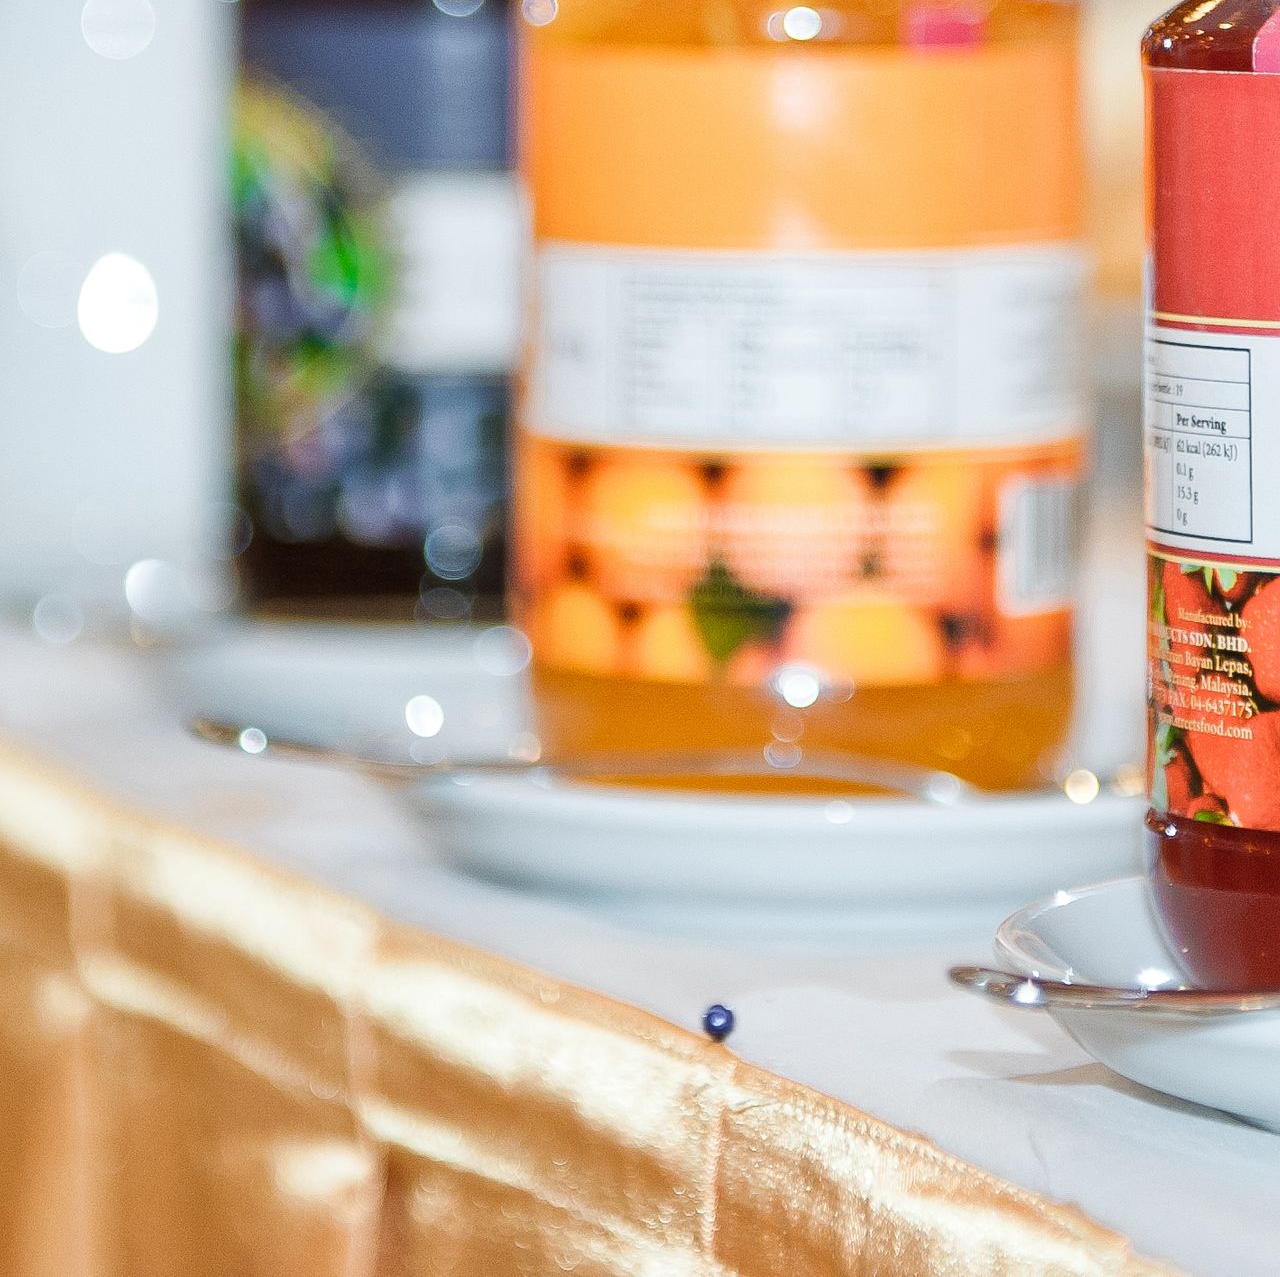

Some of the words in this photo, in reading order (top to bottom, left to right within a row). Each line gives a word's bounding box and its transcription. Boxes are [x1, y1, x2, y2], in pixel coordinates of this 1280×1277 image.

[1176, 413, 1189, 426] Per
[1191, 415, 1227, 435] Serving
[1176, 440, 1185, 453] 62
[1186, 441, 1201, 456] kcal
[1202, 442, 1222, 459] (262
[1223, 444, 1238, 462] kJ)
[1176, 462, 1187, 476] 0.1
[1188, 468, 1194, 482] g
[1177, 485, 1192, 500] 15.3
[1193, 490, 1199, 505] g
[1176, 509, 1182, 521] 0
[1182, 512, 1188, 526] g
[1178, 608, 1233, 627] Manufactured
[1235, 613, 1253, 632] by:
[1189, 633, 1216, 648] SDN.
[1217, 633, 1252, 653] BHD.
[1185, 651, 1213, 672] Bayan
[1215, 655, 1253, 678] Lepas,
[1201, 674, 1253, 698] Malaysia.
[1190, 695, 1253, 719] 04-6437175
